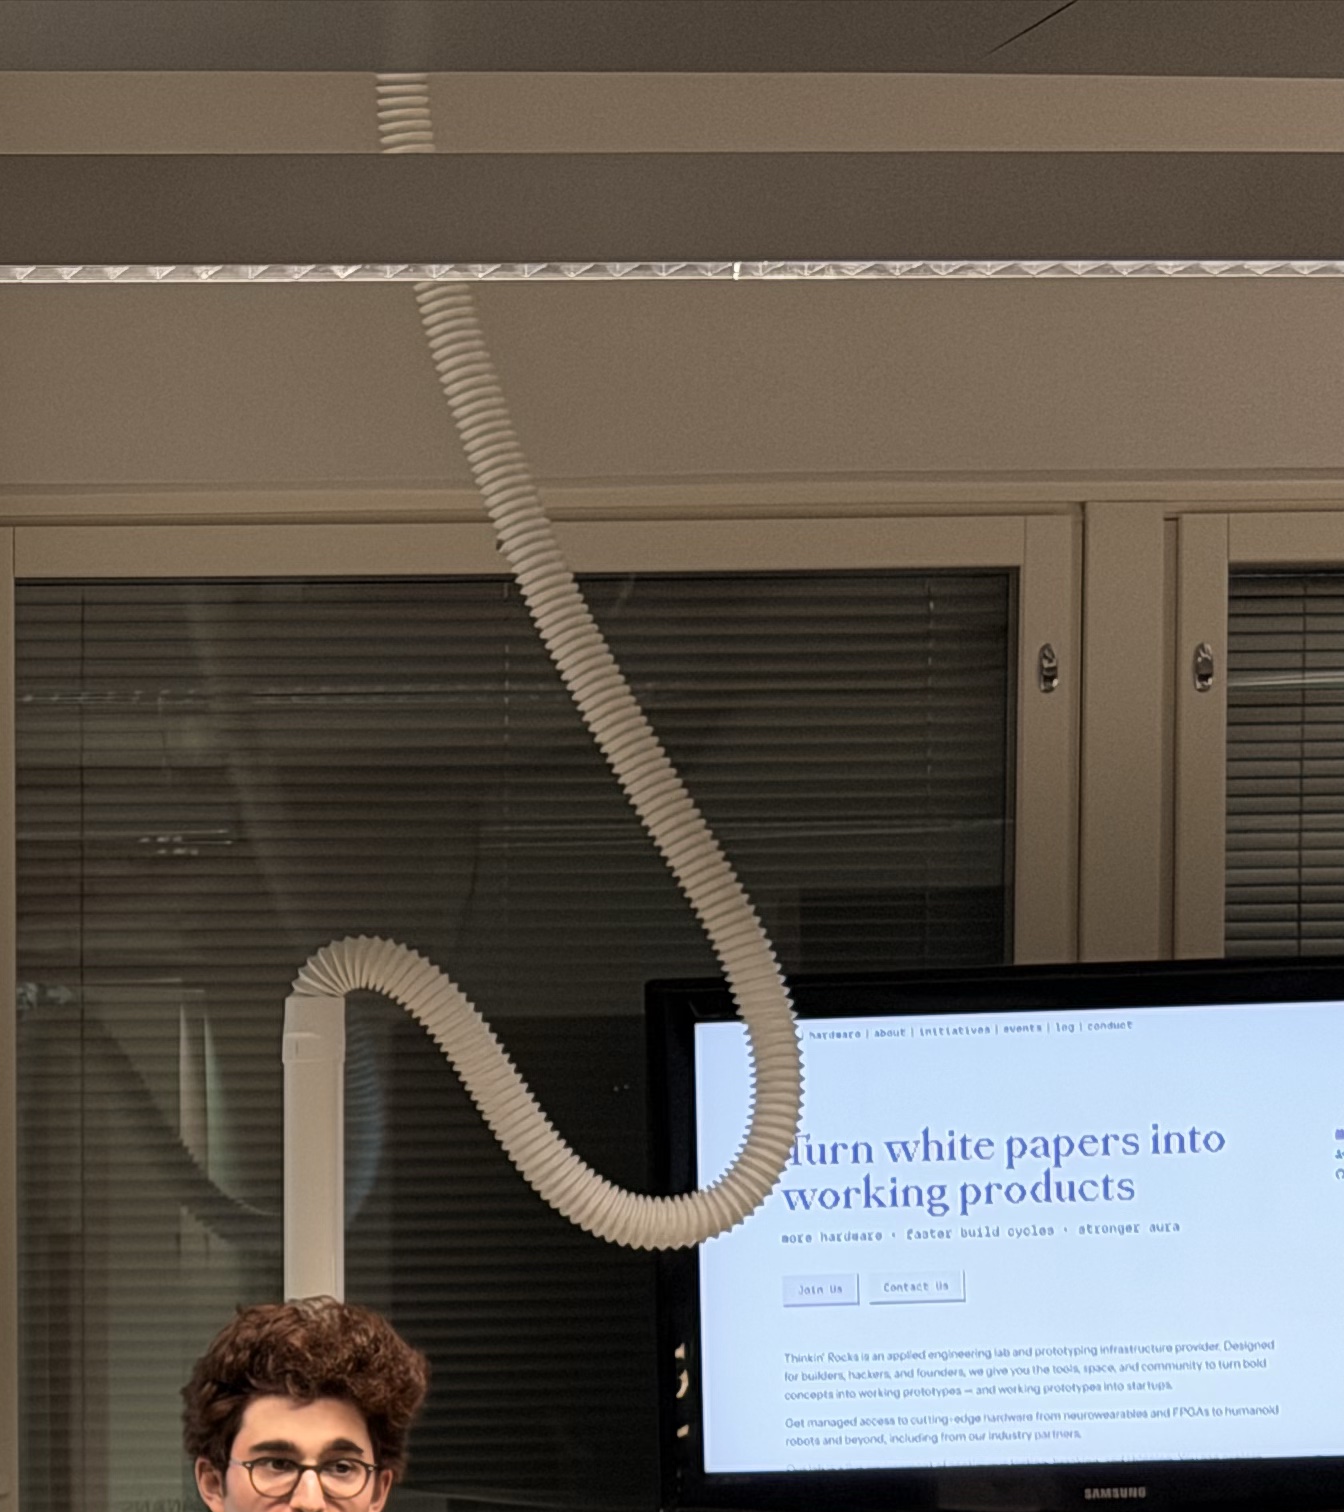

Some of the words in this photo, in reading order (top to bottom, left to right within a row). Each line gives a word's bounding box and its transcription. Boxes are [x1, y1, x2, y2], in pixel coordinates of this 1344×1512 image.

[809, 1030, 861, 1039] hardware
[874, 1029, 906, 1038] about
[919, 1026, 991, 1037] initiatives
[1003, 1024, 1042, 1034] events
[1056, 1022, 1075, 1034] log
[1087, 1021, 1133, 1031] conduct
[790, 1133, 873, 1166] Turn
[883, 1126, 995, 1162] white
[1006, 1132, 1140, 1170] papers
[1151, 1123, 1226, 1155] into
[781, 1173, 950, 1217] working
[960, 1167, 1135, 1216] products
[781, 1233, 812, 1244] more
[820, 1230, 883, 1243] hardware
[906, 1227, 952, 1240] faster
[961, 1226, 999, 1238] build
[1007, 1225, 1054, 1238] cycles
[1079, 1222, 1140, 1236] stronger
[1149, 1222, 1180, 1233] aura
[798, 1285, 823, 1295] Join
[829, 1285, 843, 1294] Us
[883, 1282, 928, 1292] Contact
[935, 1281, 949, 1291] Us
[784, 1352, 825, 1363] Thinkin'
[827, 1352, 859, 1363] Rocks
[887, 1350, 926, 1362] applied
[927, 1349, 992, 1361] engineering
[994, 1348, 1010, 1358] lab
[1012, 1347, 1032, 1357] and
[1035, 1345, 1097, 1357] prototyping
[1100, 1343, 1172, 1354] infrastructure
[1175, 1342, 1219, 1354] provider.
[1223, 1340, 1275, 1351] Designed
[784, 1371, 798, 1382] for
[801, 1370, 845, 1382] builders,
[848, 1369, 891, 1381] hackers,
[894, 1368, 913, 1378] and
[916, 1367, 966, 1378] founders,
[986, 1367, 1008, 1378] give
[1010, 1367, 1030, 1377] you
[1033, 1365, 1049, 1374] the
[1053, 1364, 1080, 1375] tools,
[1083, 1363, 1116, 1375] space,
[1119, 1361, 1139, 1372] and
[1141, 1360, 1202, 1372] community
[1205, 1360, 1216, 1370] to
[1218, 1359, 1241, 1370] turn
[1242, 1358, 1267, 1368] bold
[784, 1390, 833, 1401] concepts
[836, 1389, 856, 1399] into
[858, 1387, 900, 1399] working
[903, 1386, 961, 1399] prototypes
[976, 1385, 996, 1395] and
[998, 1383, 1041, 1395] working
[1043, 1382, 1101, 1394] prototypes
[1103, 1381, 1124, 1391] into
[1127, 1380, 1172, 1392] startups.
[785, 1417, 805, 1428] Get
[807, 1417, 857, 1429] managed
[860, 1416, 895, 1427] access
[897, 1415, 908, 1426] to
[910, 1414, 981, 1426] cutting-edge
[984, 1413, 1032, 1423] hardware
[1036, 1411, 1061, 1422] from
[1063, 1408, 1148, 1420] neurowearables
[1151, 1408, 1170, 1418] and
[1172, 1406, 1210, 1417] FPGAs
[1212, 1406, 1223, 1417] to
[1224, 1405, 1279, 1416] humanoid
[785, 1435, 820, 1447] robots
[823, 1435, 842, 1446] and
[844, 1433, 887, 1446] beyond,
[889, 1432, 938, 1444] including
[941, 1431, 966, 1442] from
[969, 1431, 985, 1441] our
[988, 1430, 1032, 1442] industry
[1034, 1429, 1081, 1441] partners.
[1084, 1487, 1146, 1500] SAMSUNG
